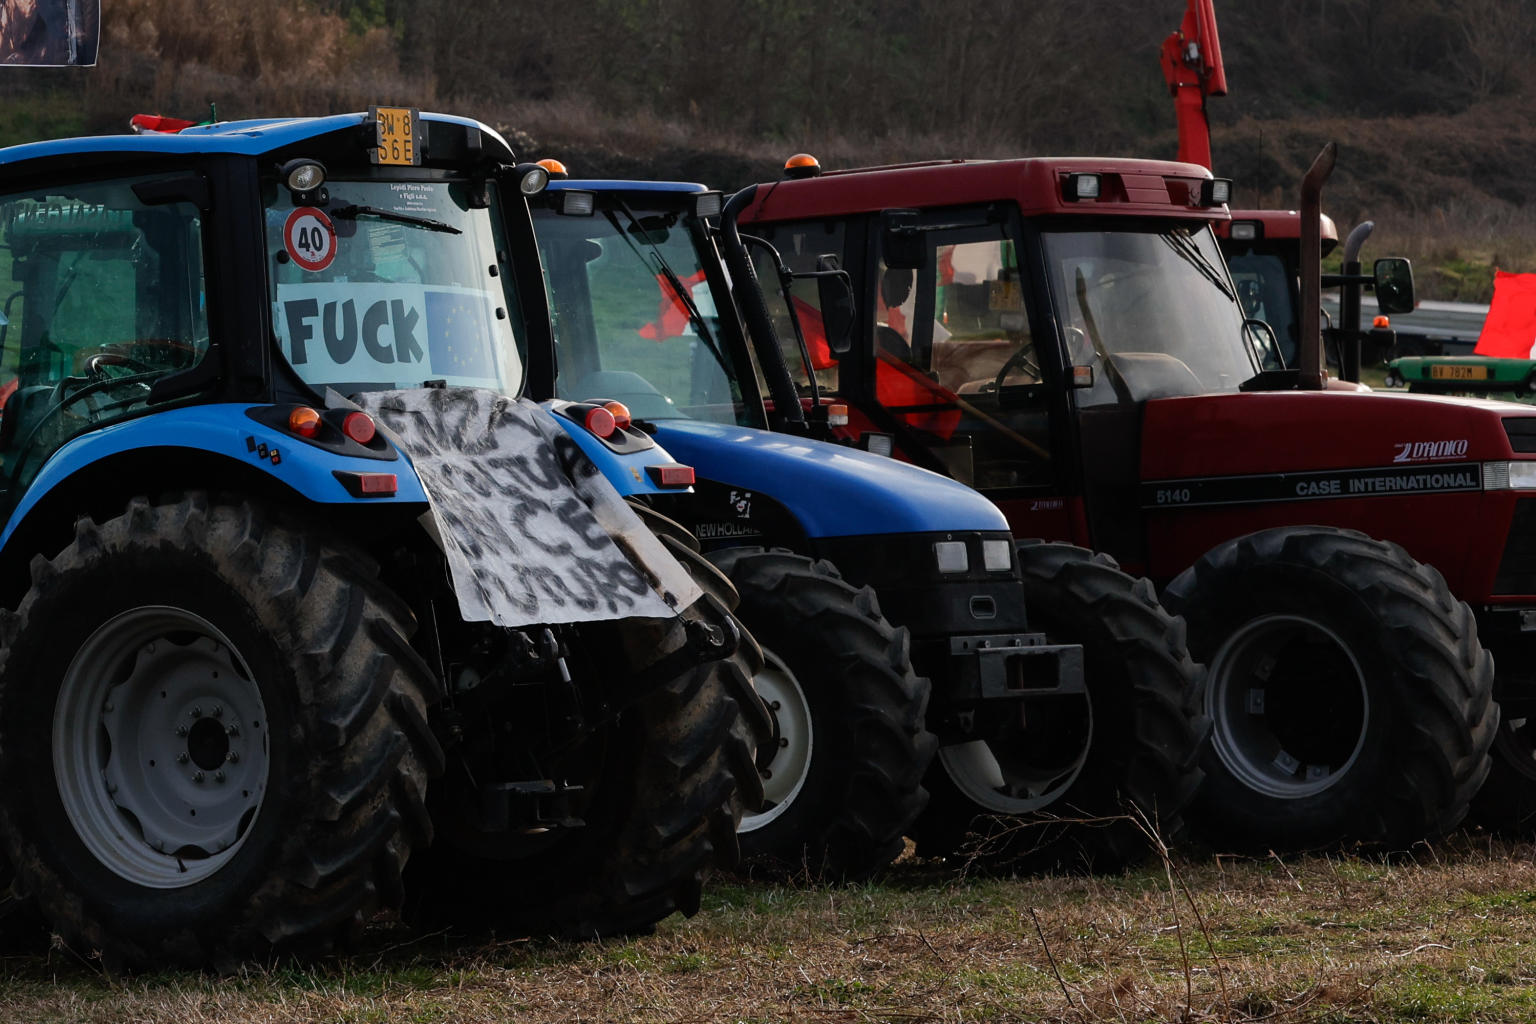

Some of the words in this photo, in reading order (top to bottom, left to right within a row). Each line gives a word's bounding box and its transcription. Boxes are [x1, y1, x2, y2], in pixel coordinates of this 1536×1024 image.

[378, 113, 395, 136] BW
[403, 115, 411, 136] 8
[298, 226, 324, 252] 40
[283, 297, 424, 365] FUCK
[1296, 480, 1341, 496] CASE
[1349, 473, 1476, 493] INTERNATIONAL
[1156, 489, 1191, 504] 5140
[696, 523, 716, 537] NEW
